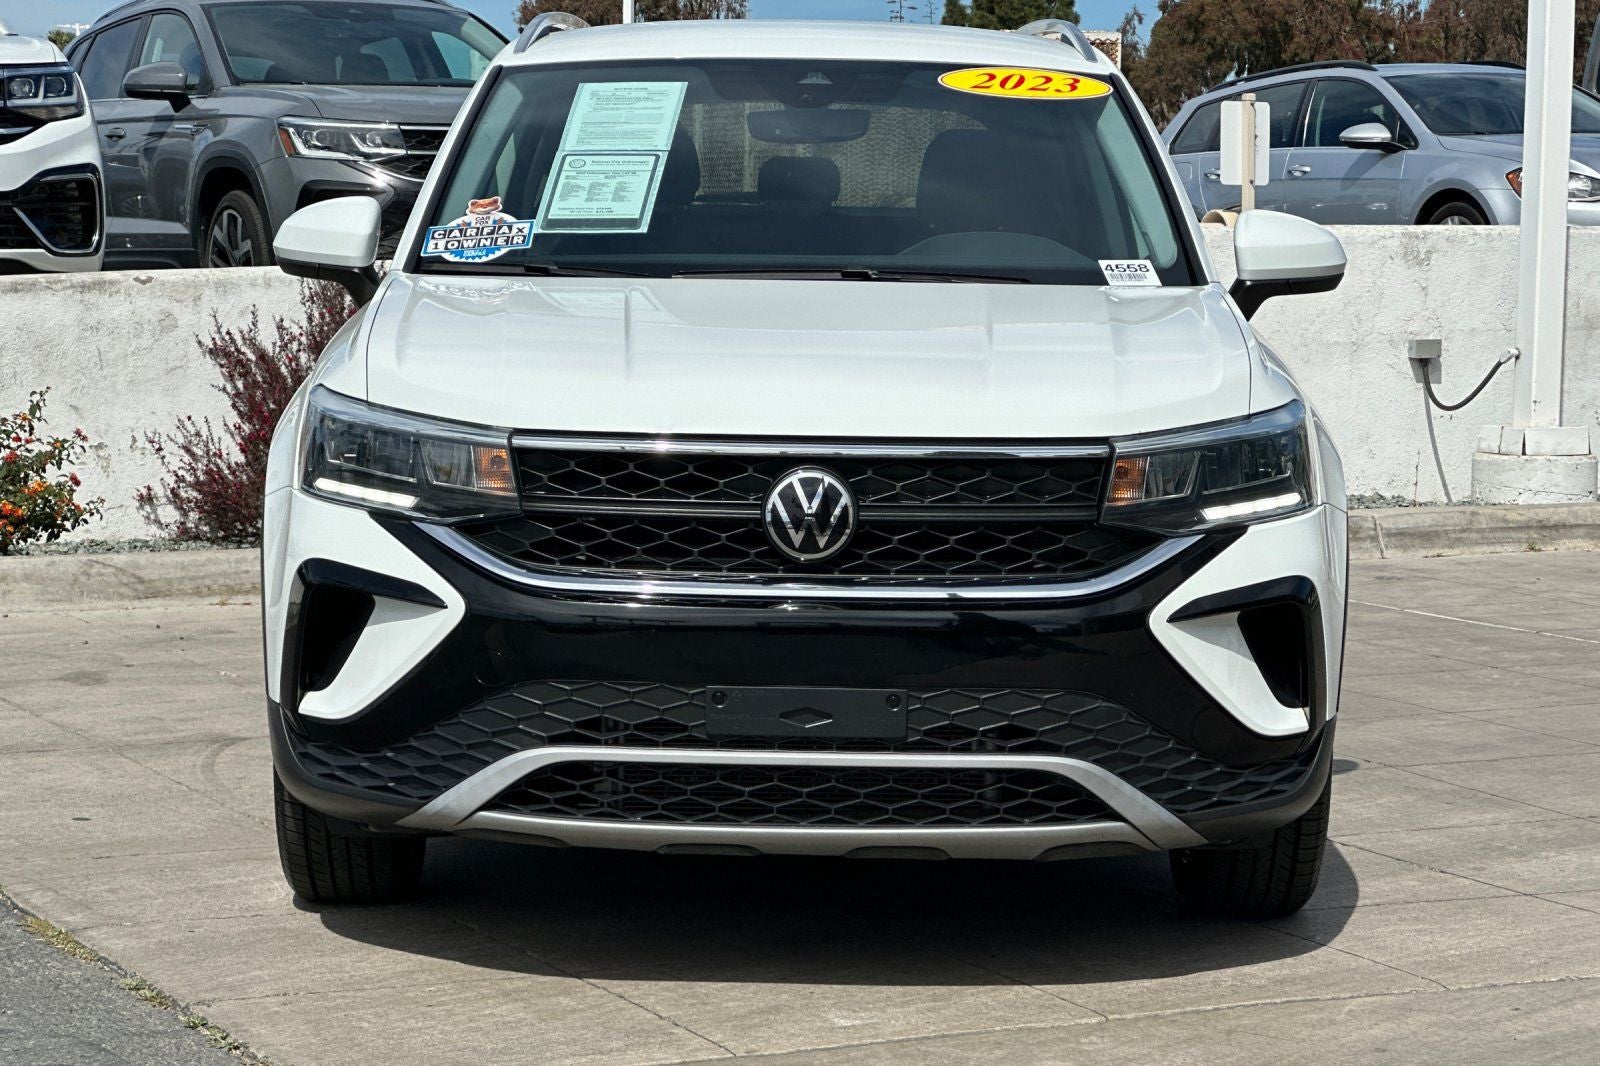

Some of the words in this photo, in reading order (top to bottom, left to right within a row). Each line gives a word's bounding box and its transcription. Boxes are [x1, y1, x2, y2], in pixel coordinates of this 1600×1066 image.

[969, 72, 1081, 94] 2023
[432, 225, 527, 239] CARFAX
[1104, 263, 1150, 273] 4558
